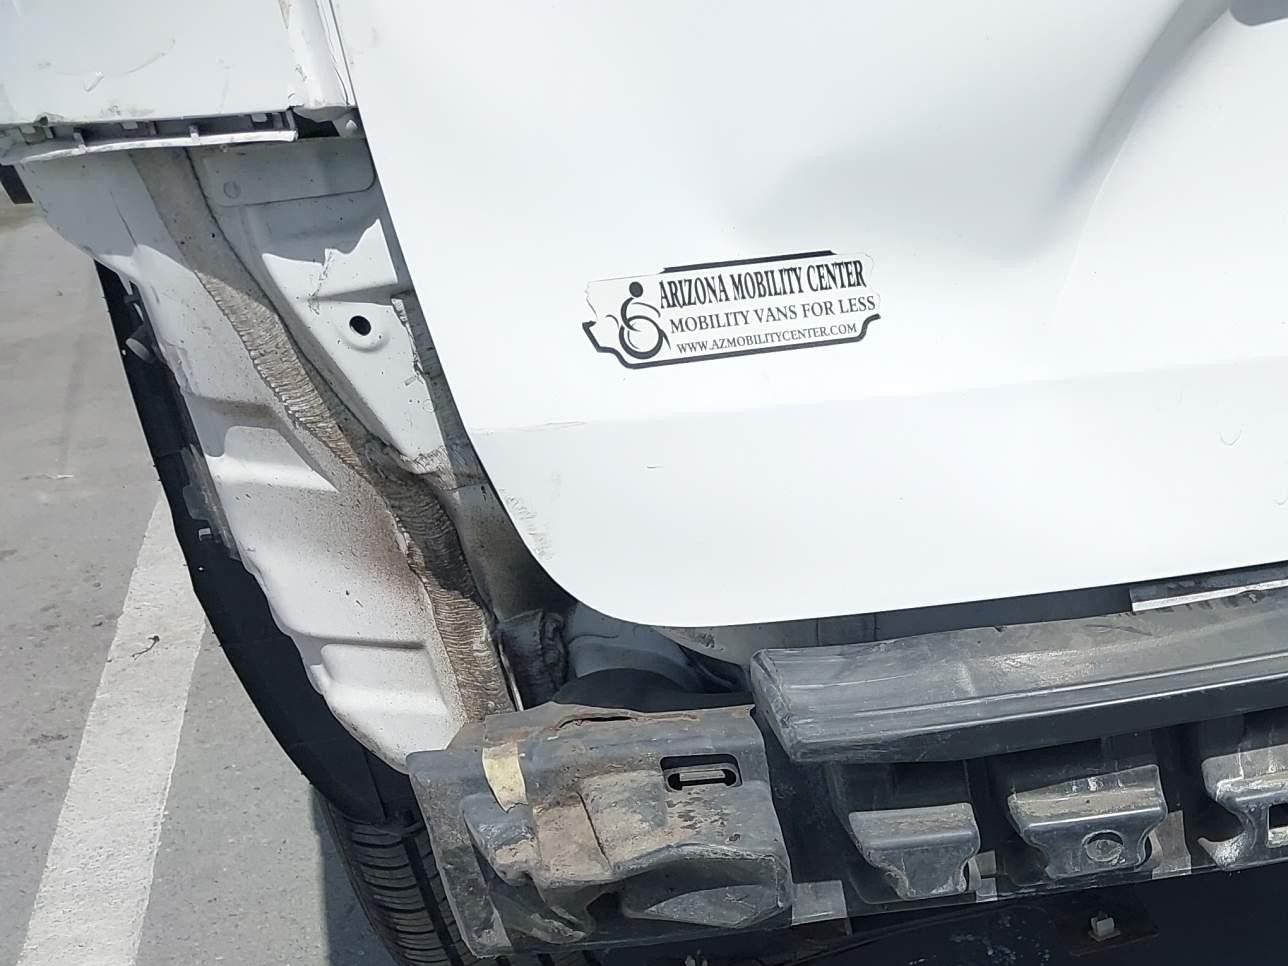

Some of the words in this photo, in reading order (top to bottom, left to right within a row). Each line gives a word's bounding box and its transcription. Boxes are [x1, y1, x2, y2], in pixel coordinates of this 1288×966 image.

[658, 274, 729, 310] ARIZONA
[729, 266, 803, 300] MOBILITY
[807, 259, 867, 292] CENTER
[670, 310, 750, 334] MOBILITY
[753, 304, 798, 324] VANS
[801, 300, 834, 319] FOR
[839, 295, 876, 314] LESS
[676, 323, 858, 354] WWW.AZMOBILITYCENTER.COM
